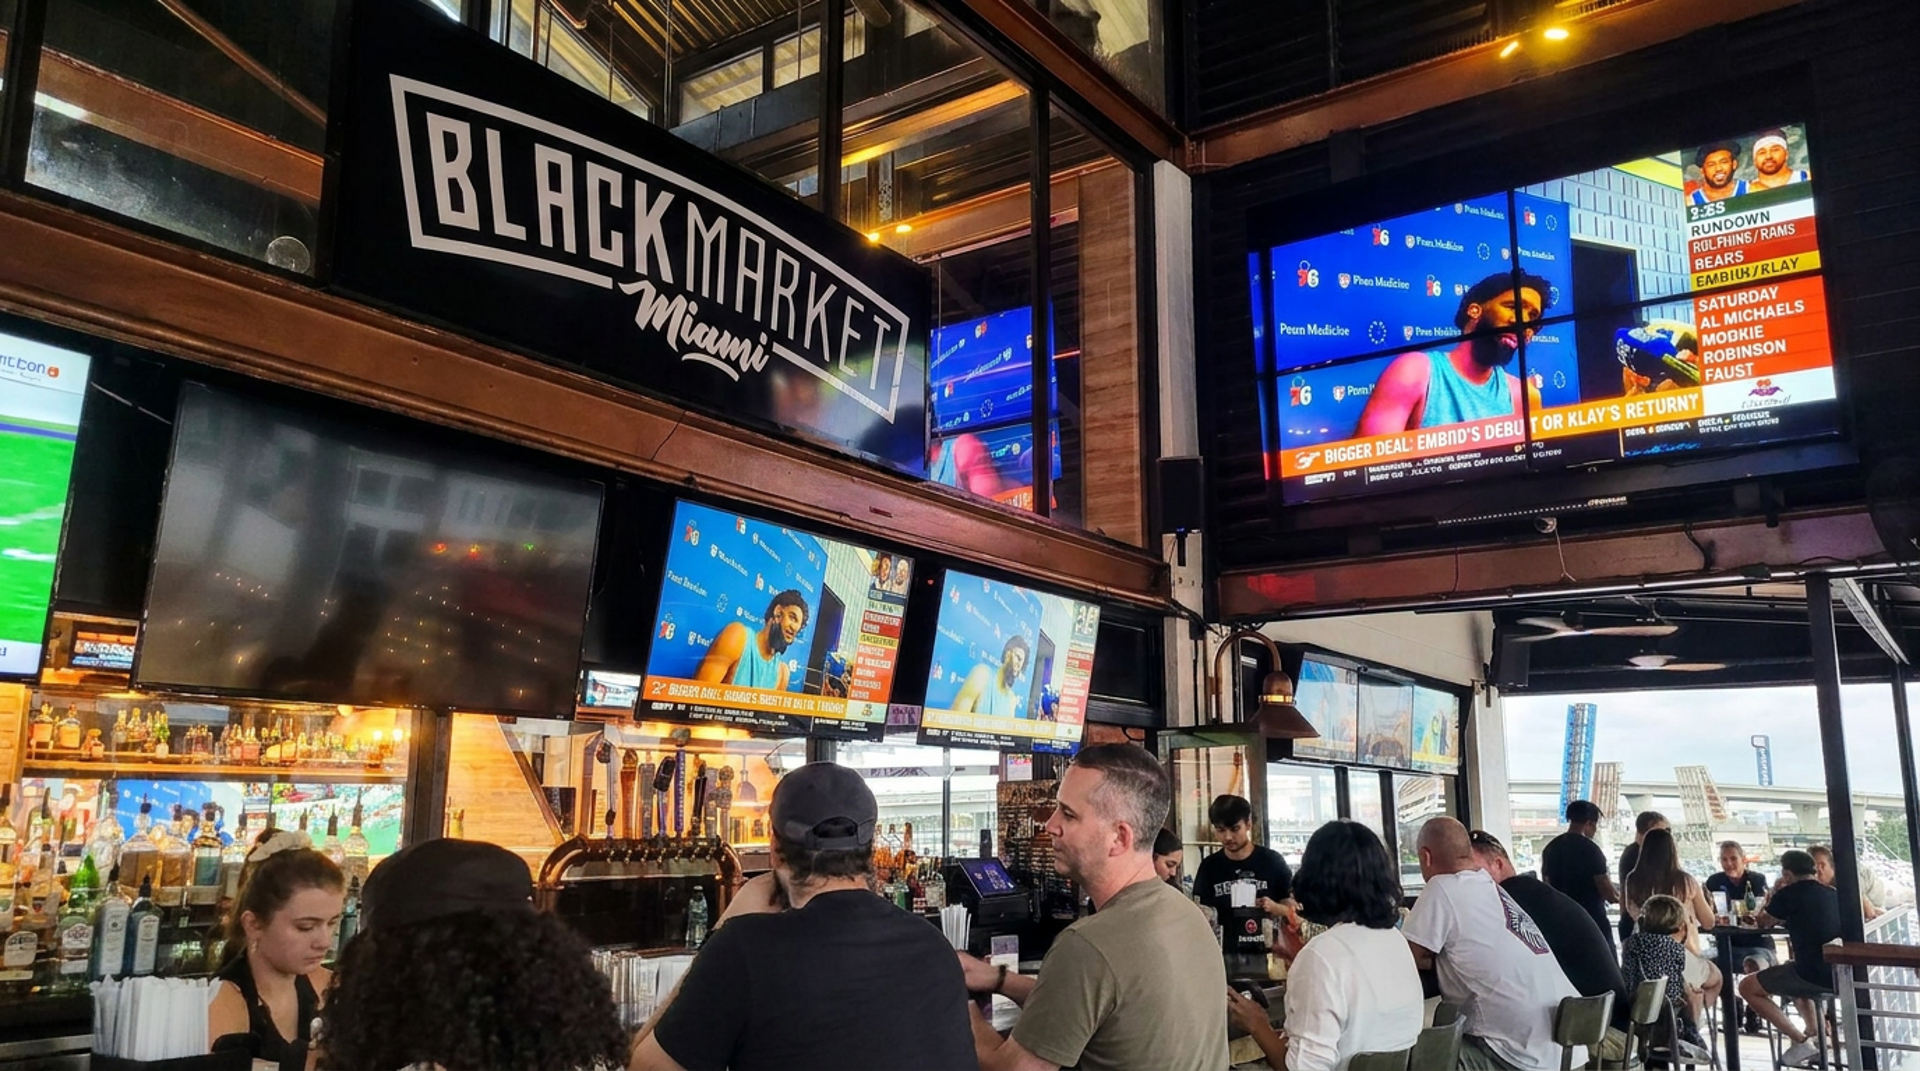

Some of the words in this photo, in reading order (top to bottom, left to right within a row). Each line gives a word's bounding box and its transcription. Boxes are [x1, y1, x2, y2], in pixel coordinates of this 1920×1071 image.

[1691, 211, 1770, 237] RUNDOWN
[1695, 250, 1745, 271] BEARS
[1698, 286, 1779, 312] SATURDAY
[1700, 315, 1721, 329] AL
[1724, 300, 1805, 325] MICHAELS
[618, 280, 770, 381] Miami
[1703, 339, 1787, 364] ROBINSON
[1705, 362, 1754, 381] FAUST
[1324, 443, 1372, 464] BIGGER
[1542, 413, 1564, 430] OR
[1567, 404, 1621, 427] KLAY'S
